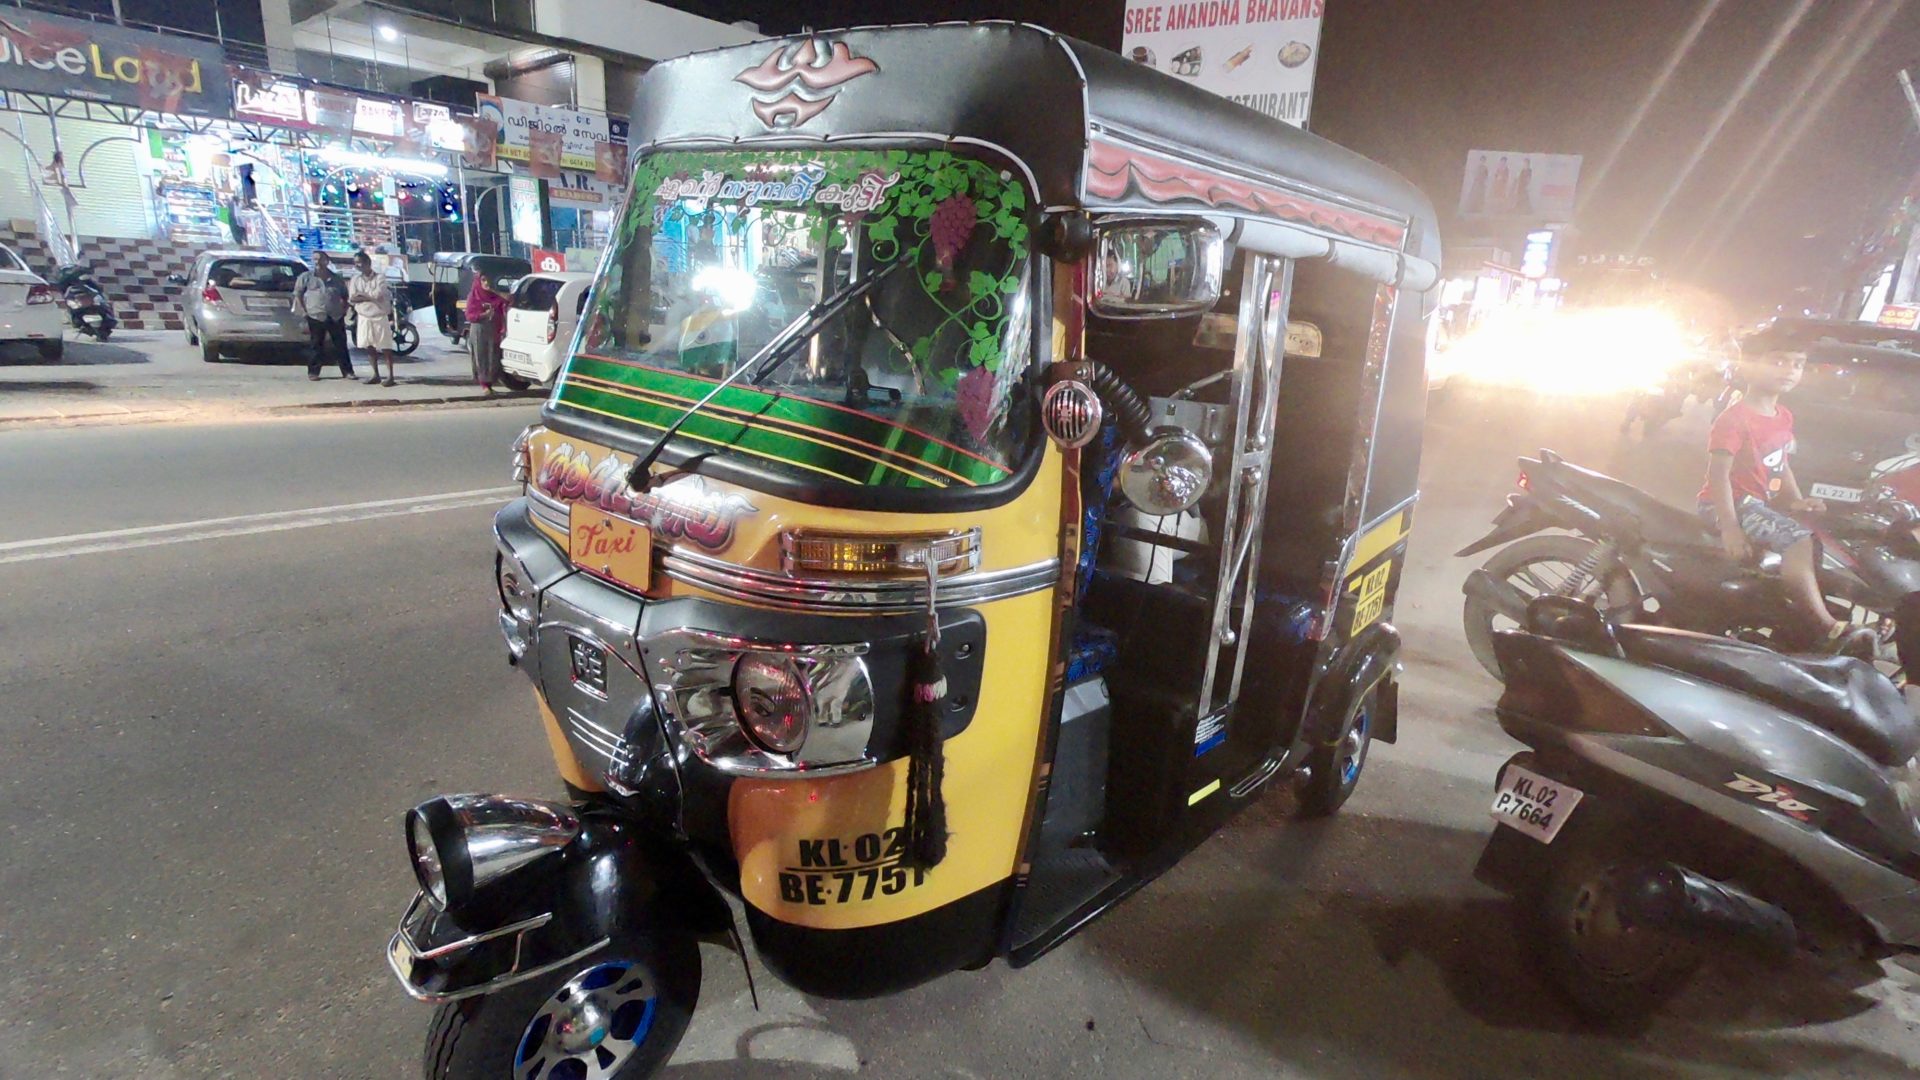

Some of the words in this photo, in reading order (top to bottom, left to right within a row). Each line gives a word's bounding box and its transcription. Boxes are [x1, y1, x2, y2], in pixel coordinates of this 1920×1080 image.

[1125, 6, 1162, 34] SREE
[1166, 0, 1240, 31] ANANDHA
[576, 523, 637, 558] Taxi
[1497, 792, 1554, 831] P.7664
